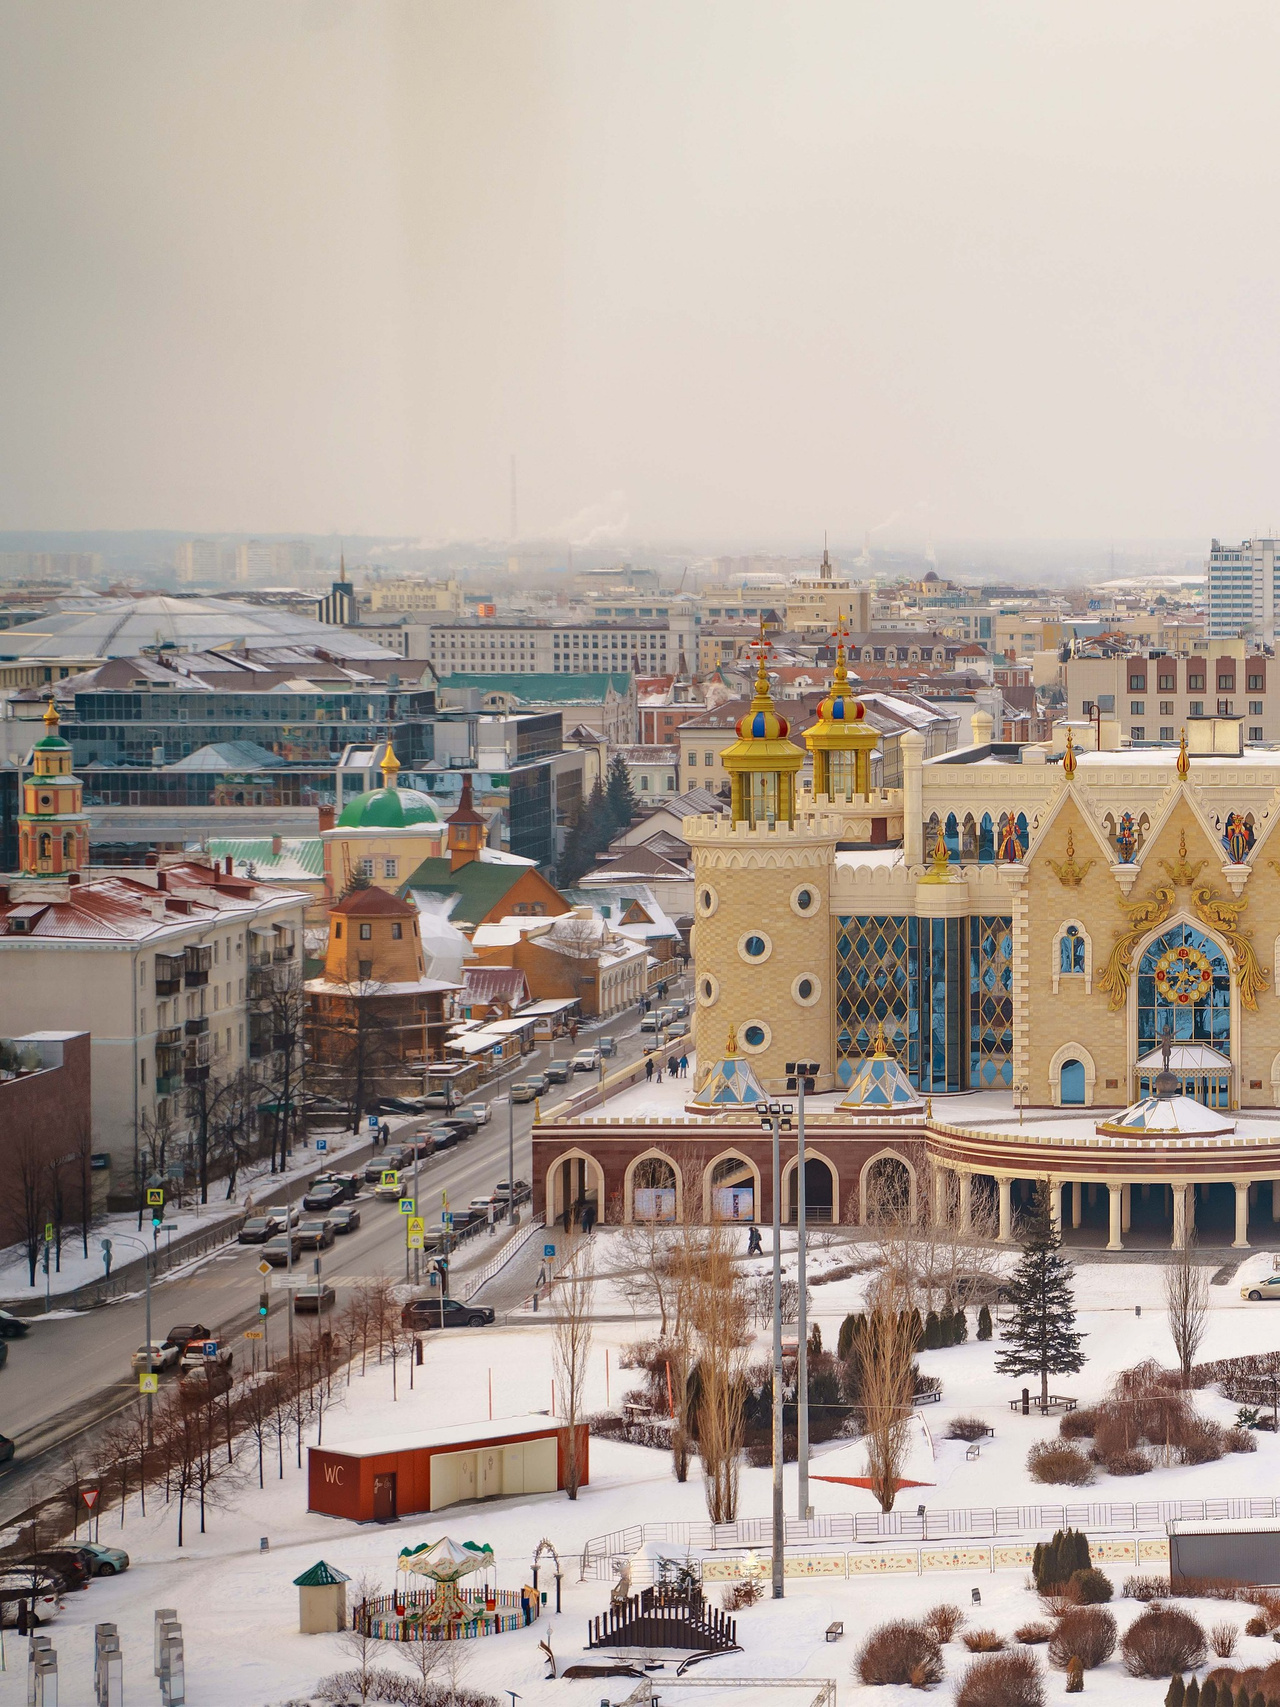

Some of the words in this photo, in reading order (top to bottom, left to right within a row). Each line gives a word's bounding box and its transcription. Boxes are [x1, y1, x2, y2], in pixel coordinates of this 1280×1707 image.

[495, 1046, 501, 1054] P
[370, 1117, 377, 1125] P
[318, 1141, 325, 1149] P
[206, 1344, 214, 1354] P
[323, 1462, 345, 1486] WC
